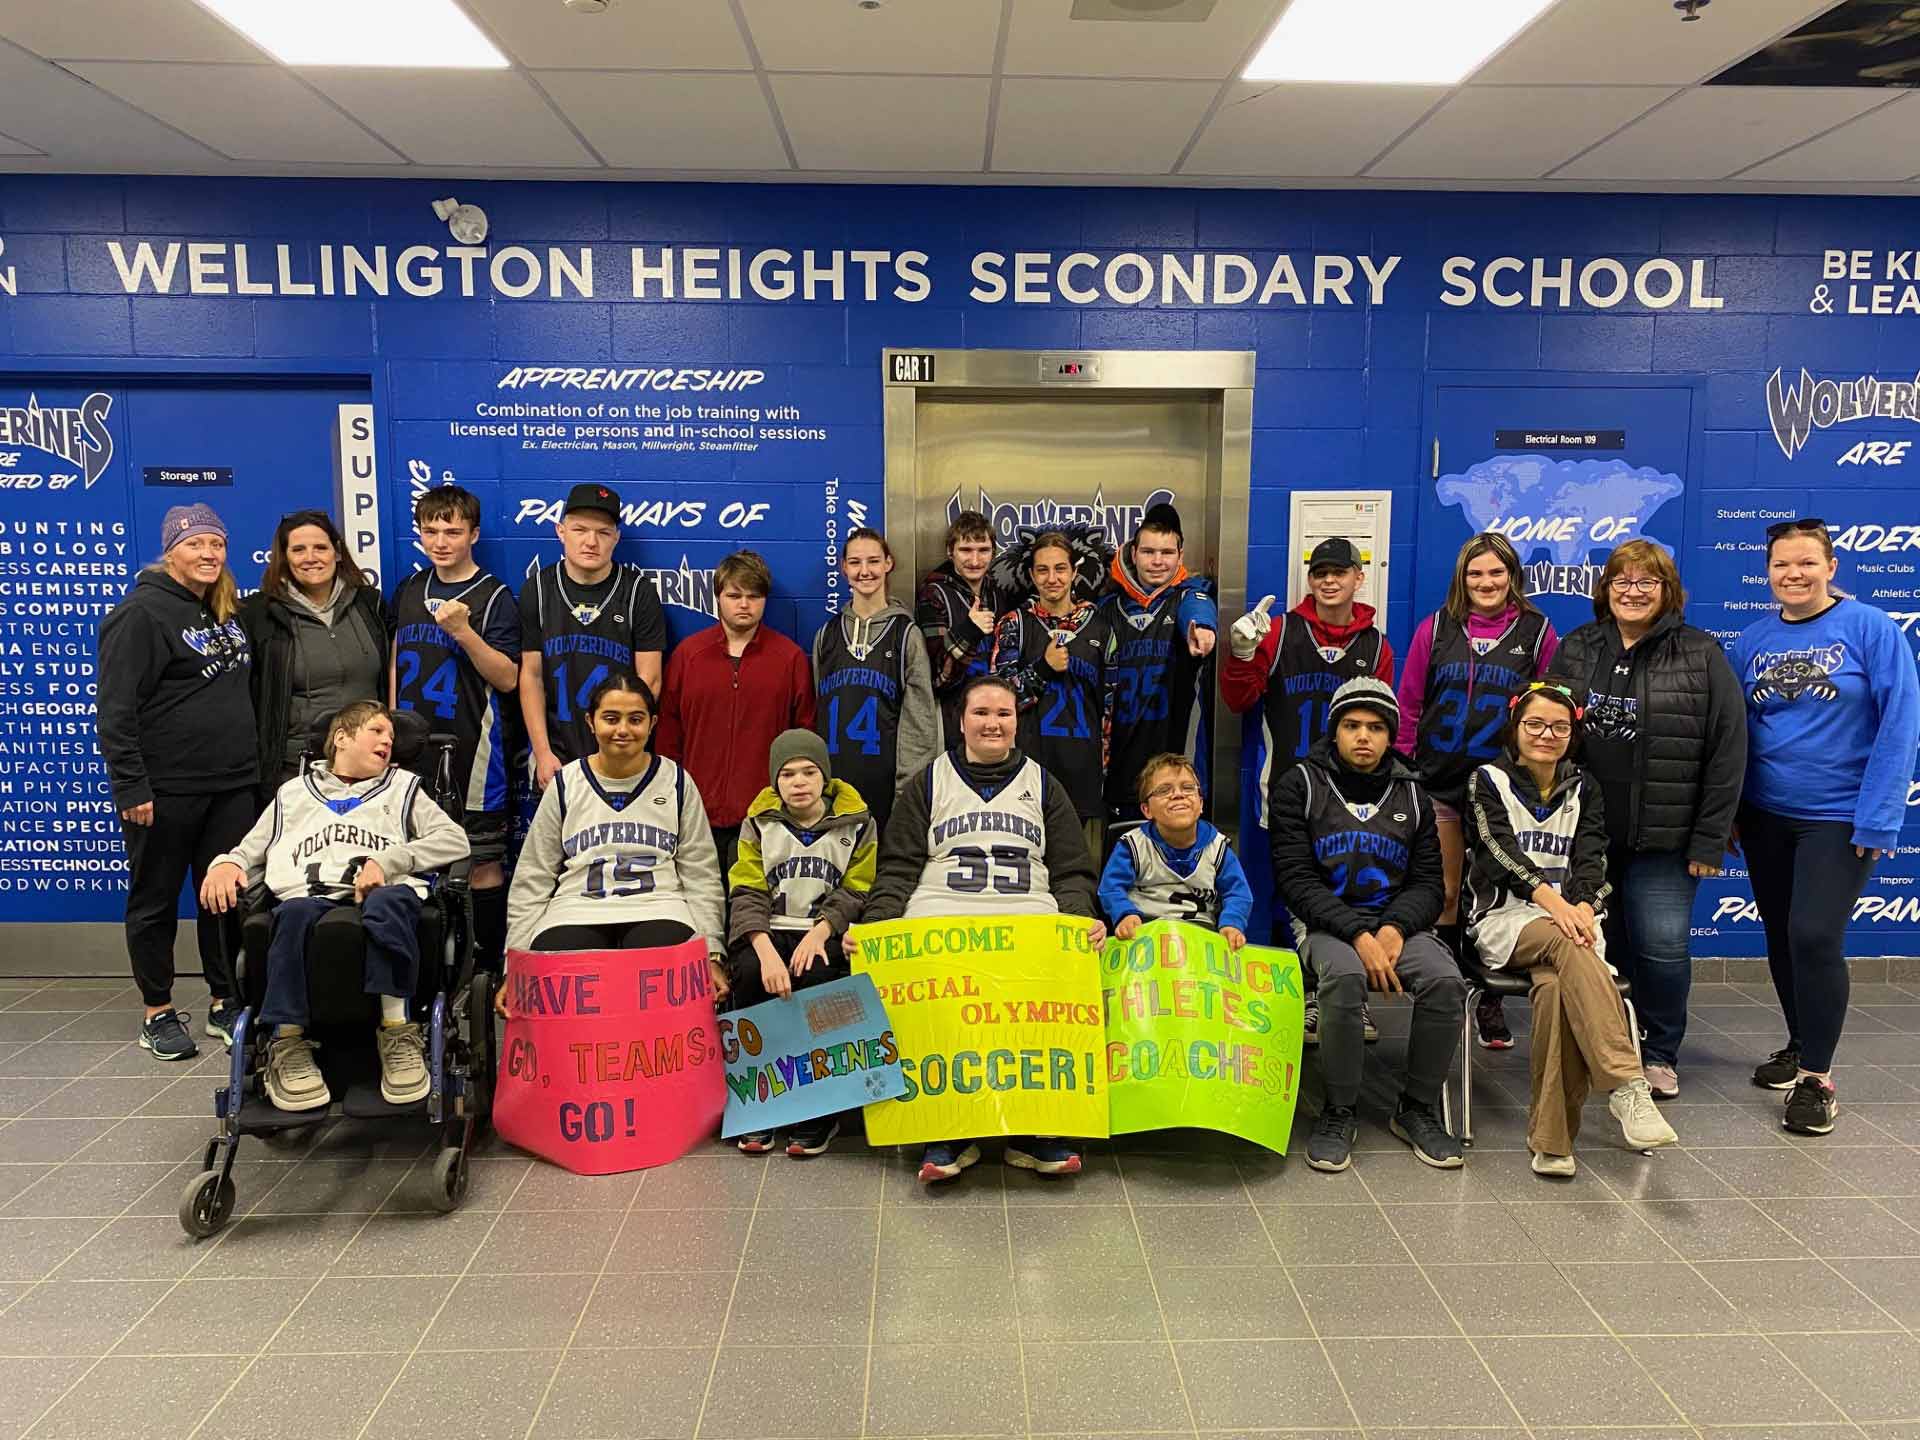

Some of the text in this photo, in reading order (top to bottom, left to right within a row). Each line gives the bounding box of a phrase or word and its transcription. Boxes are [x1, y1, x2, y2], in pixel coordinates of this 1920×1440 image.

[107, 241, 1724, 308] WELLINGTON HEIGHTS SECONDARY SCHOOL
[1823, 249, 1873, 280] BE
[1810, 284, 1833, 313] &
[497, 366, 766, 392] APPRENTICESHIP
[895, 355, 929, 381] CAR 1
[476, 402, 800, 422] Combination of on the job training with
[450, 422, 826, 440] licensed trade persons and in-school sessions
[1525, 434, 1596, 444] Electrical Room 109
[522, 441, 758, 452] Ex. Electrician, Mason, Millwright, Steamfitter
[1837, 441, 1911, 466] ARE
[48, 474, 78, 489] BY
[160, 471, 217, 483] Storage 110
[514, 498, 770, 528] PAWAYS OF
[1717, 510, 1795, 519] Student Council
[1484, 516, 1637, 542] HOME OF
[0, 541, 126, 556] BIOLOGY
[824, 478, 840, 615] Take co-op to try
[1715, 543, 1735, 551] Arts
[36, 562, 127, 576] CAREERS
[1742, 575, 1769, 586] Relay
[1857, 564, 1915, 573] Music Clubs
[0, 583, 128, 596] CHEMISTRY
[1872, 589, 1910, 598] Athletic
[1724, 601, 1748, 610] Field
[0, 623, 94, 637] TRUCTI
[32, 643, 92, 656] ENGL
[544, 634, 631, 665] WOLVERINES
[1326, 650, 1338, 662] W
[35, 663, 94, 676] STUD
[397, 651, 458, 720] 24
[819, 667, 897, 700] WOLVERINES
[1041, 682, 1091, 739] 21
[1430, 689, 1509, 758] 32
[41, 722, 98, 736] HIST
[826, 695, 881, 756] 14
[0, 801, 57, 814] ATION
[564, 821, 678, 858] WOLVERINES
[933, 811, 1042, 848] WOLVERINES
[1313, 831, 1409, 867] WOLVERINES
[581, 853, 657, 900] 15
[947, 844, 1031, 894] 35
[1880, 876, 1914, 886] Improv
[861, 924, 1091, 964] WELCOME TO
[1689, 928, 1719, 936] DECA
[1205, 940, 1301, 999] LUCK
[515, 959, 712, 1015] HAVE FUN!
[876, 975, 980, 1006] PECIAL
[961, 1000, 1100, 1026] OLYMPICS
[719, 1017, 763, 1065] GO
[508, 1026, 716, 1088] GO, TEAMS,
[727, 1030, 900, 1105] WOLVERINES
[896, 1047, 1096, 1103] SOCCER!
[1105, 1038, 1295, 1103] COACHES!
[559, 1098, 636, 1143] GO!
